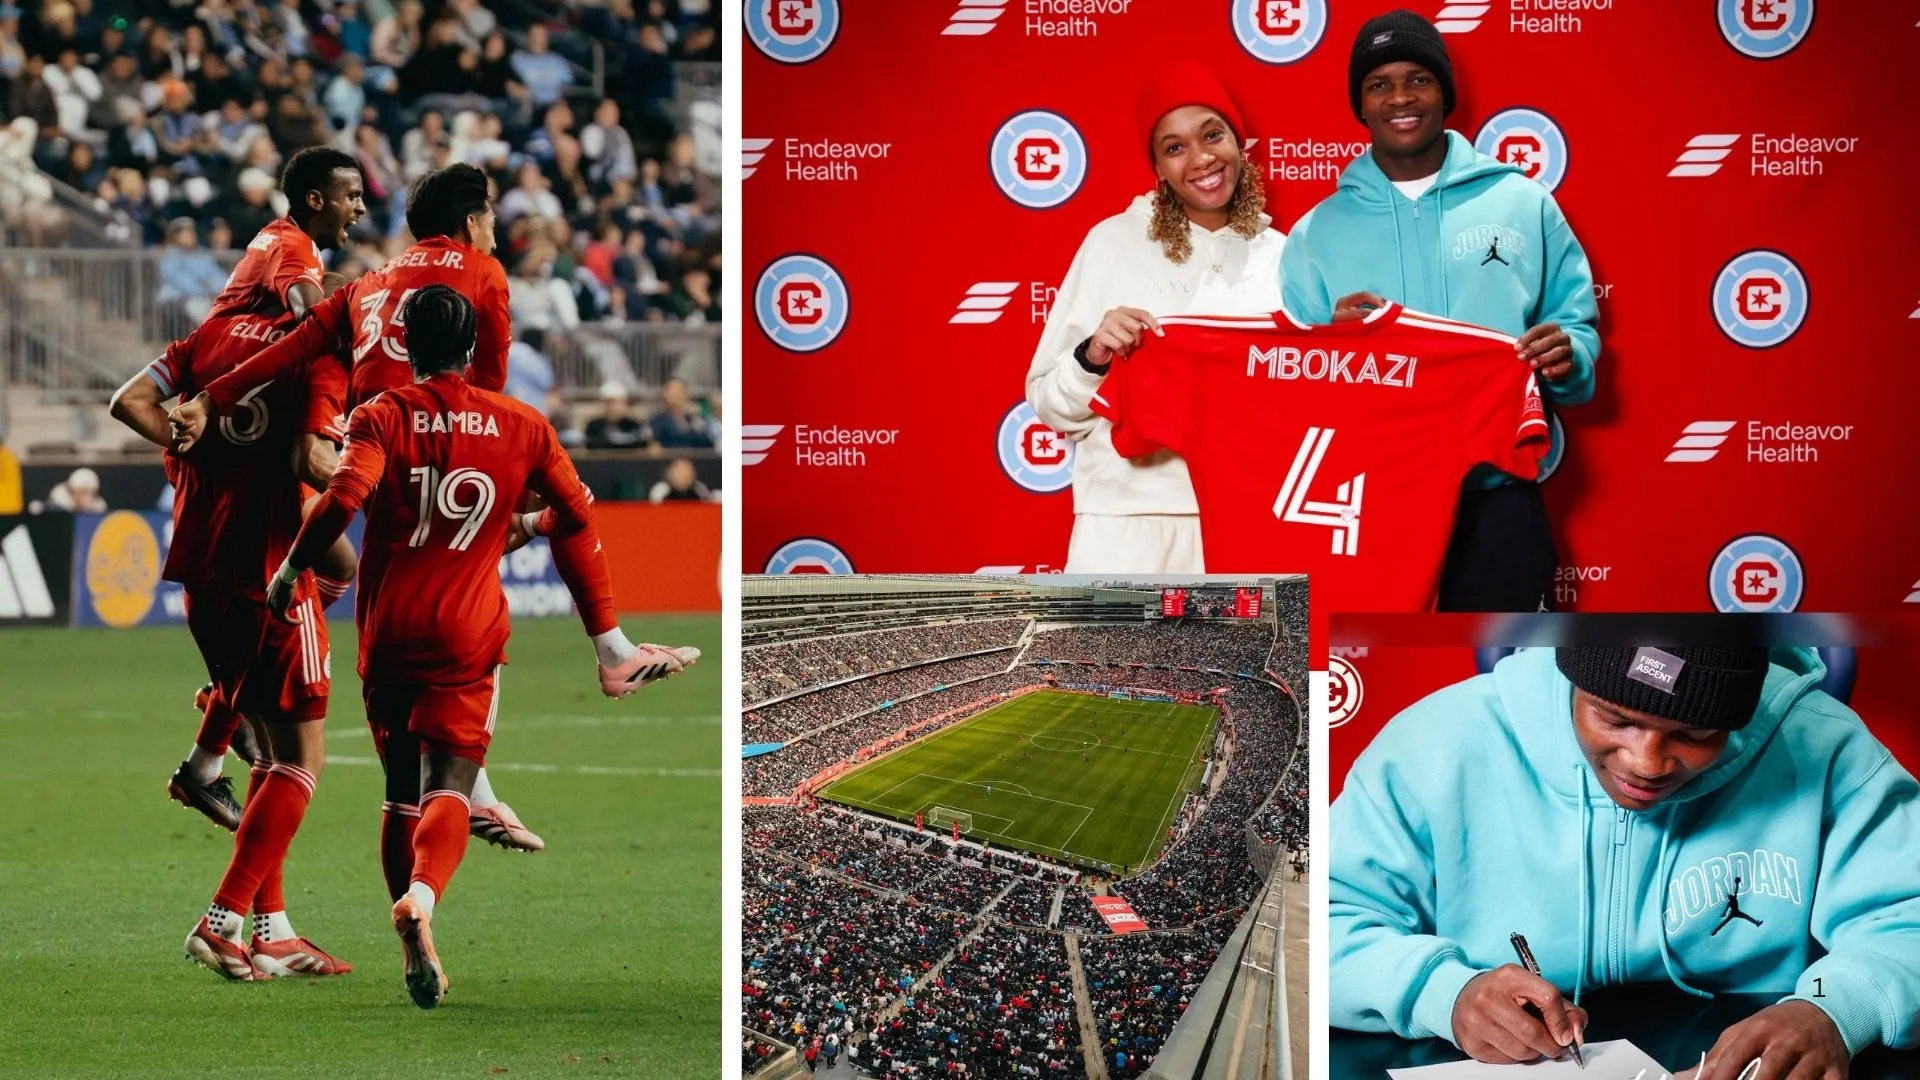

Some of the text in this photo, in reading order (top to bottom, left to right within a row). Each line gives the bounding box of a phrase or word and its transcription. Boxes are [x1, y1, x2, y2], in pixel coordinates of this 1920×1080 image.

[1025, 0, 1132, 14] Endeavor
[1025, 16, 1097, 37] Health
[1510, 12, 1582, 33] Health
[785, 138, 892, 158] Endeavor
[1751, 133, 1859, 153] Endeavor
[785, 160, 858, 181] Health
[1269, 160, 1340, 181] Health
[1751, 155, 1823, 176] Health
[1453, 224, 1526, 263] JORDAN
[433, 250, 464, 270] JR.
[1247, 344, 1418, 389] MBOKAZI
[413, 410, 500, 438] BAMBA
[795, 424, 899, 445] Endeavor
[1747, 420, 1854, 441] Endeavor
[796, 446, 866, 467] Health
[1747, 442, 1818, 463] Health
[1272, 426, 1366, 557] 4
[408, 466, 496, 552] 19
[1636, 663, 1674, 684] ASCENT
[1640, 655, 1667, 671] FIRST
[1663, 849, 1802, 935] JORDAN
